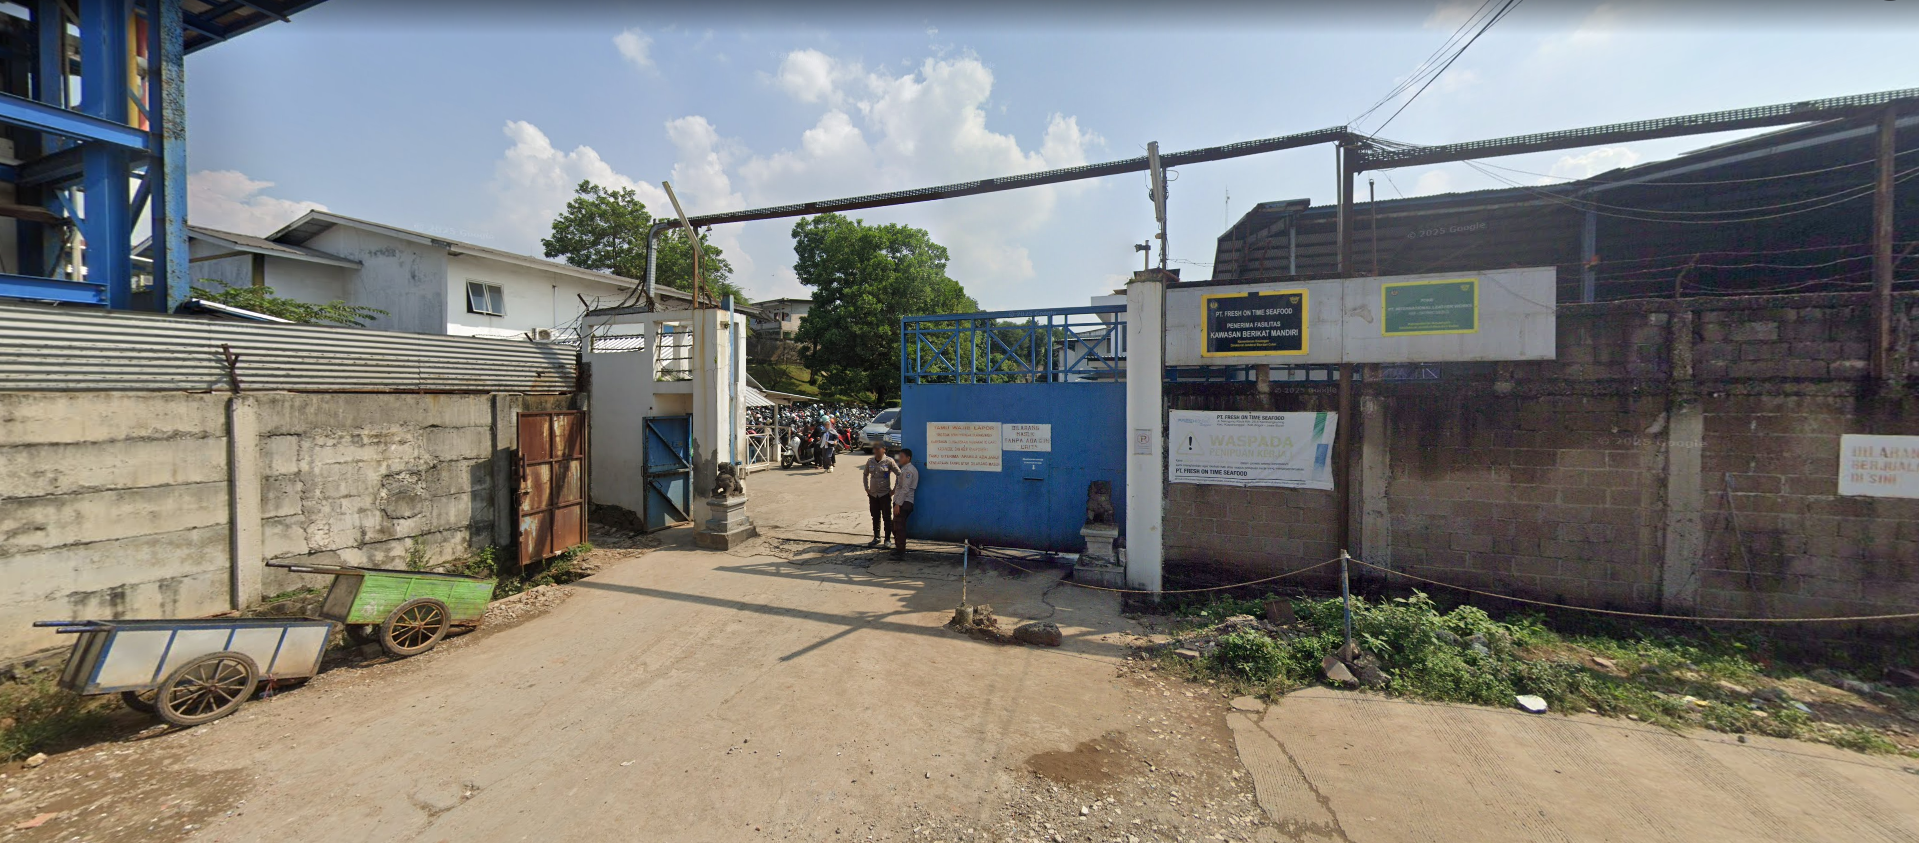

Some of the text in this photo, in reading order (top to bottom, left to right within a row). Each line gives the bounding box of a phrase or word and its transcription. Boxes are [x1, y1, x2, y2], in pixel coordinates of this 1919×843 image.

[1210, 331, 1241, 339] KAWASAN
[1242, 330, 1269, 338] BERIKAT
[1208, 434, 1294, 448] WASPADA
[1209, 447, 1254, 458] PENIPUAN
[1256, 449, 1287, 459] KERJA
[1868, 474, 1897, 485] SINI
